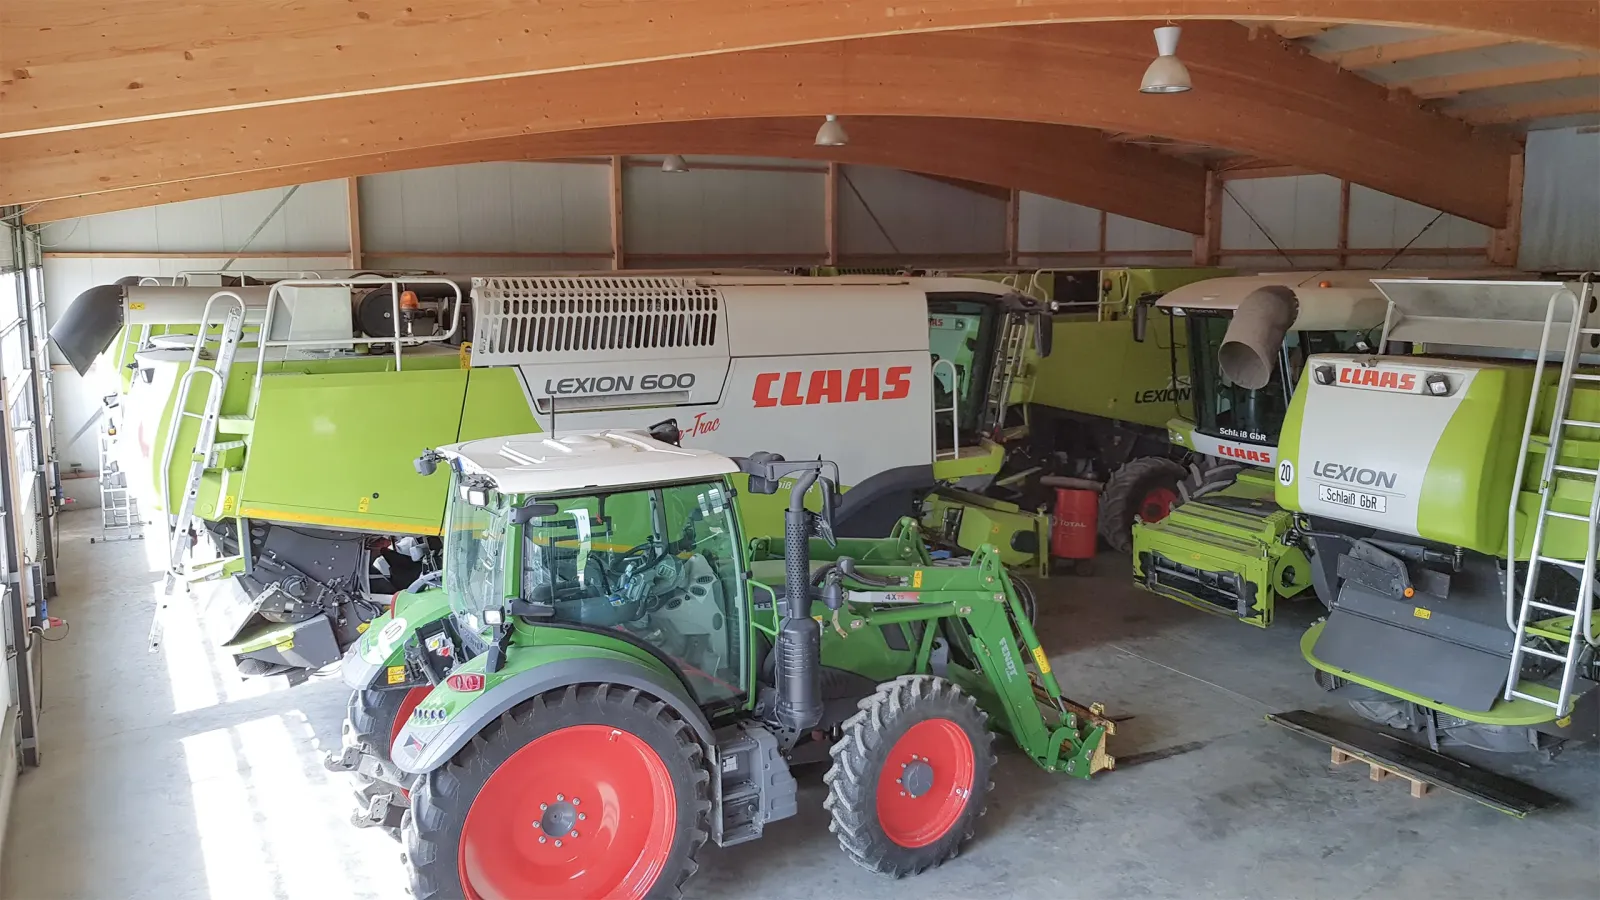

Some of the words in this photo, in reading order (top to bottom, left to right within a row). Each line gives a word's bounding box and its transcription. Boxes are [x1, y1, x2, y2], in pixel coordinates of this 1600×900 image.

[545, 375, 634, 395] LEXION
[640, 373, 696, 390] 600
[752, 366, 912, 408] CLAAS
[1340, 367, 1417, 390] CLAAS
[1134, 388, 1191, 404] LEXION
[1249, 432, 1267, 442] GbR
[1217, 444, 1271, 463] CLAAS
[1280, 463, 1291, 482] 20
[1313, 460, 1398, 489] LEXION
[1326, 487, 1356, 506] Schlaiß
[1360, 493, 1377, 510] GbR
[1060, 519, 1088, 528] TOTAL
[999, 636, 1018, 676] FENDT
